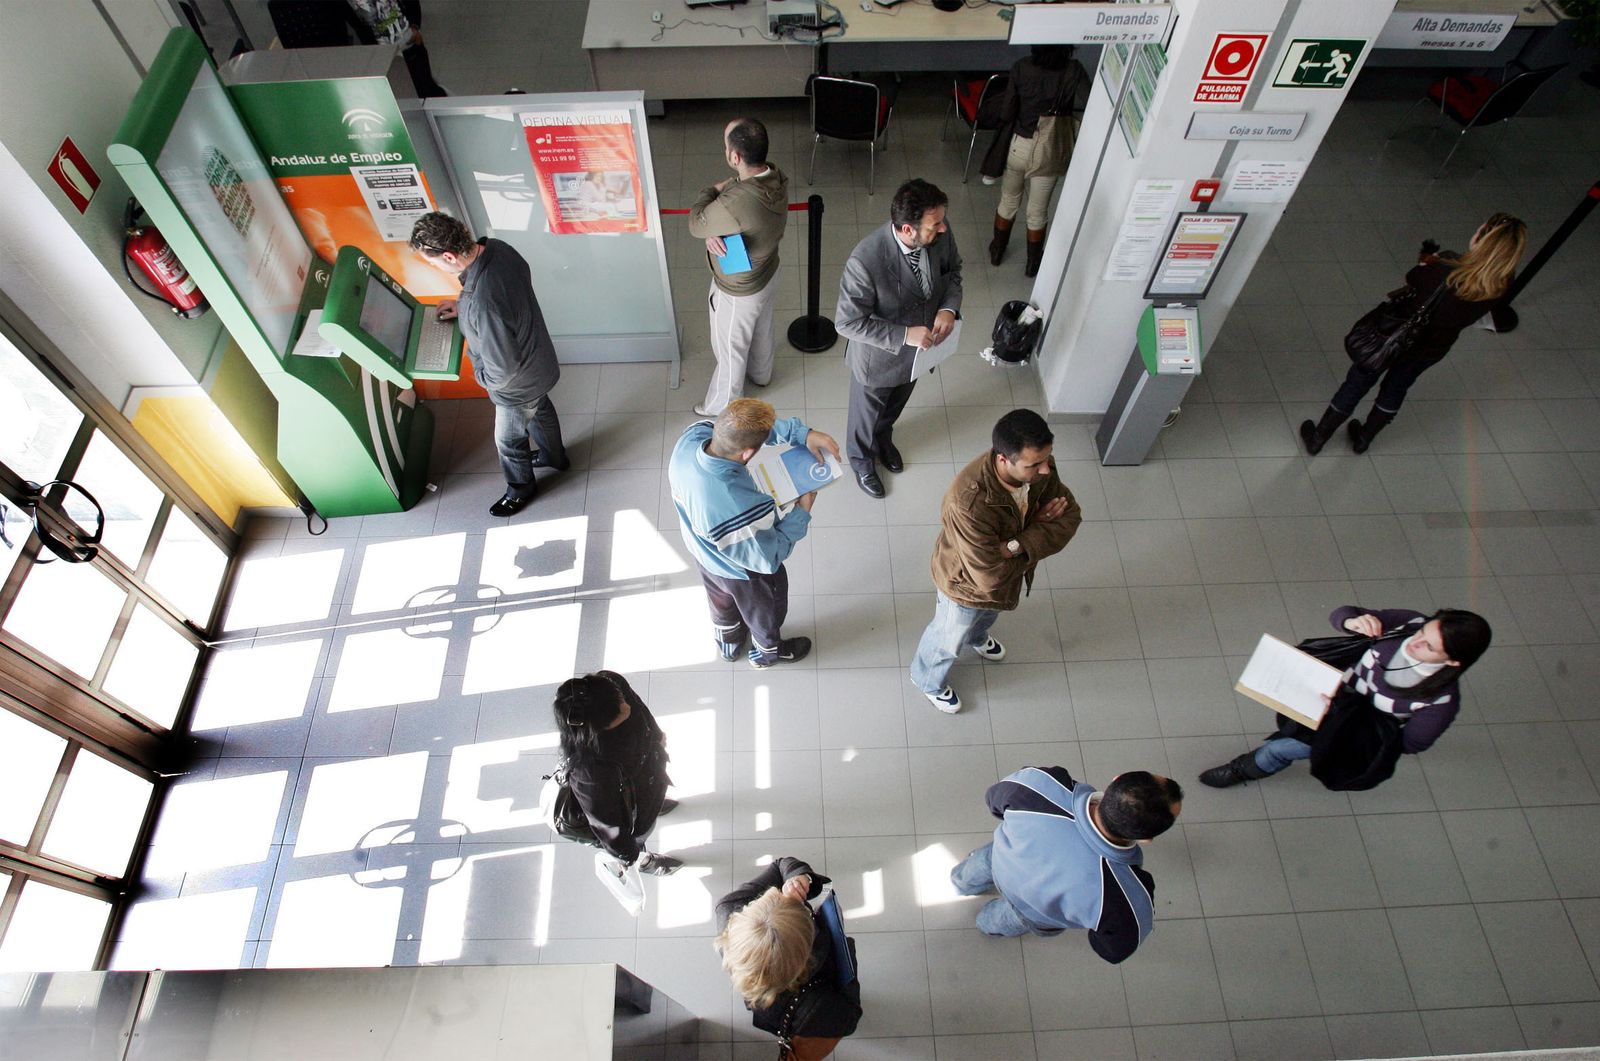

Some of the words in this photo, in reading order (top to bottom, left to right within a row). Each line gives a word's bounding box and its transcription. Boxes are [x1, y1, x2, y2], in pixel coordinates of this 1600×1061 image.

[1096, 11, 1159, 25] Demandas
[1412, 17, 1438, 31] Alta
[1440, 18, 1503, 33] Demandas
[1200, 84, 1241, 92] PULSADOR
[523, 115, 574, 126] OFICINA
[576, 113, 627, 125] VIRTUAL
[1229, 126, 1250, 136] Coja
[1265, 126, 1292, 135] Turno
[271, 155, 327, 166] Andaluz
[330, 153, 348, 163] de
[350, 152, 402, 164] Empleo
